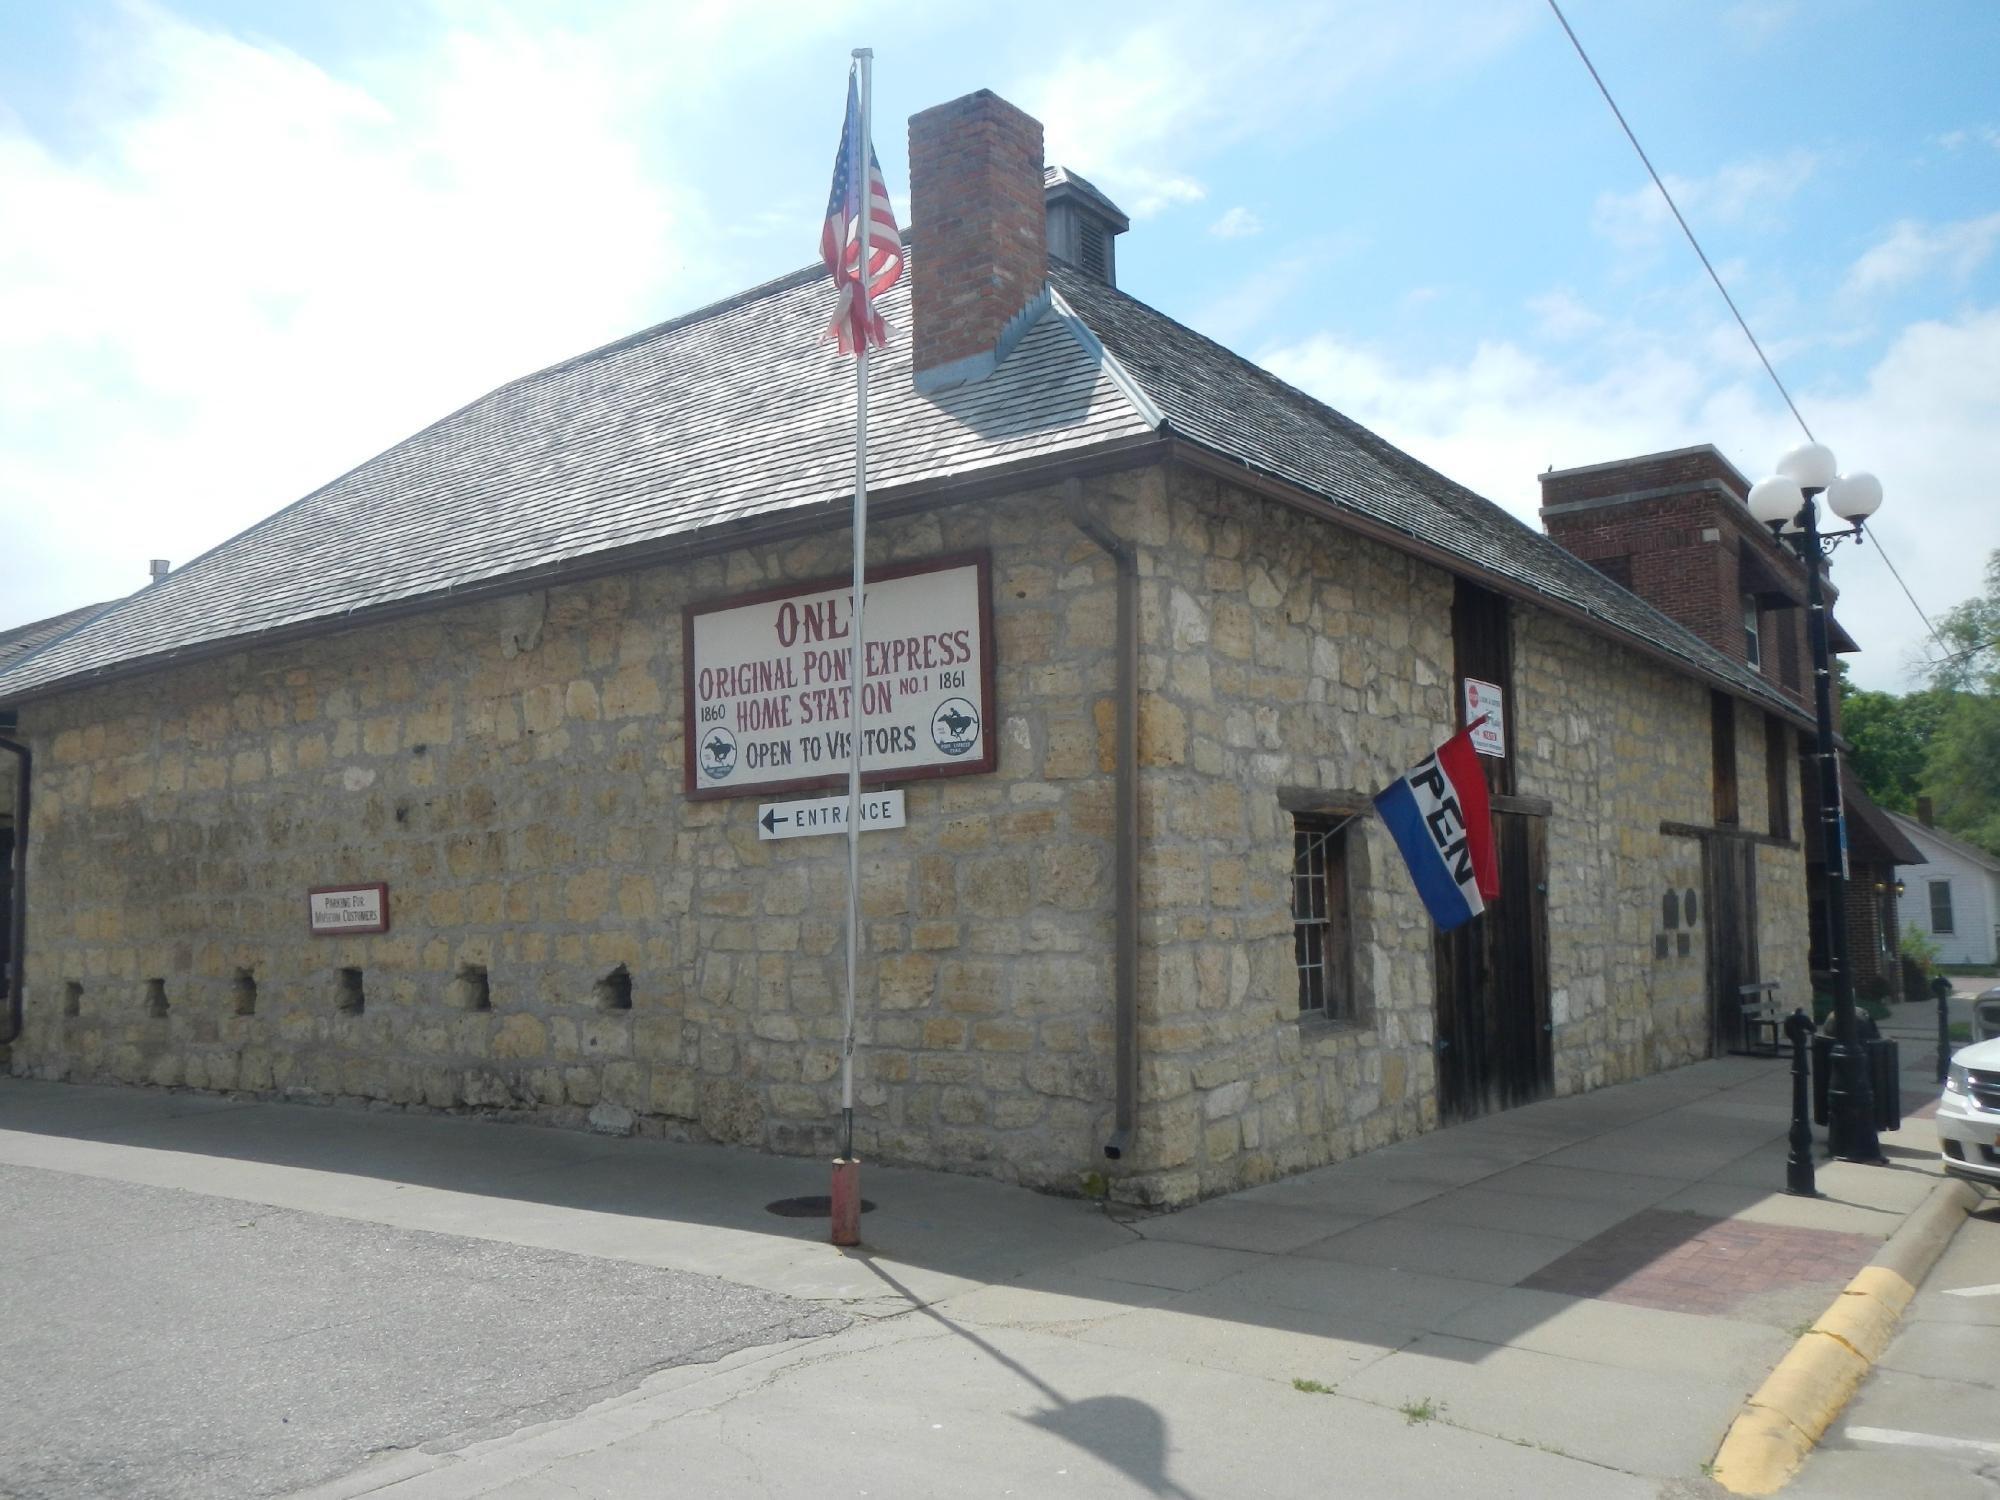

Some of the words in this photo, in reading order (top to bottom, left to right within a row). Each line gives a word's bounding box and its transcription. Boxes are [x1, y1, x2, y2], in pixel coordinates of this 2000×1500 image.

[699, 657, 798, 702] ORIGINAL
[865, 630, 971, 677] EXPRESS
[940, 670, 965, 689] 1861
[701, 703, 726, 722] 1860
[736, 694, 793, 733] HOME
[799, 680, 892, 725] STATON
[746, 740, 792, 769] OPEN
[799, 736, 822, 763] TO
[343, 910, 378, 921] CUSTOMERS
